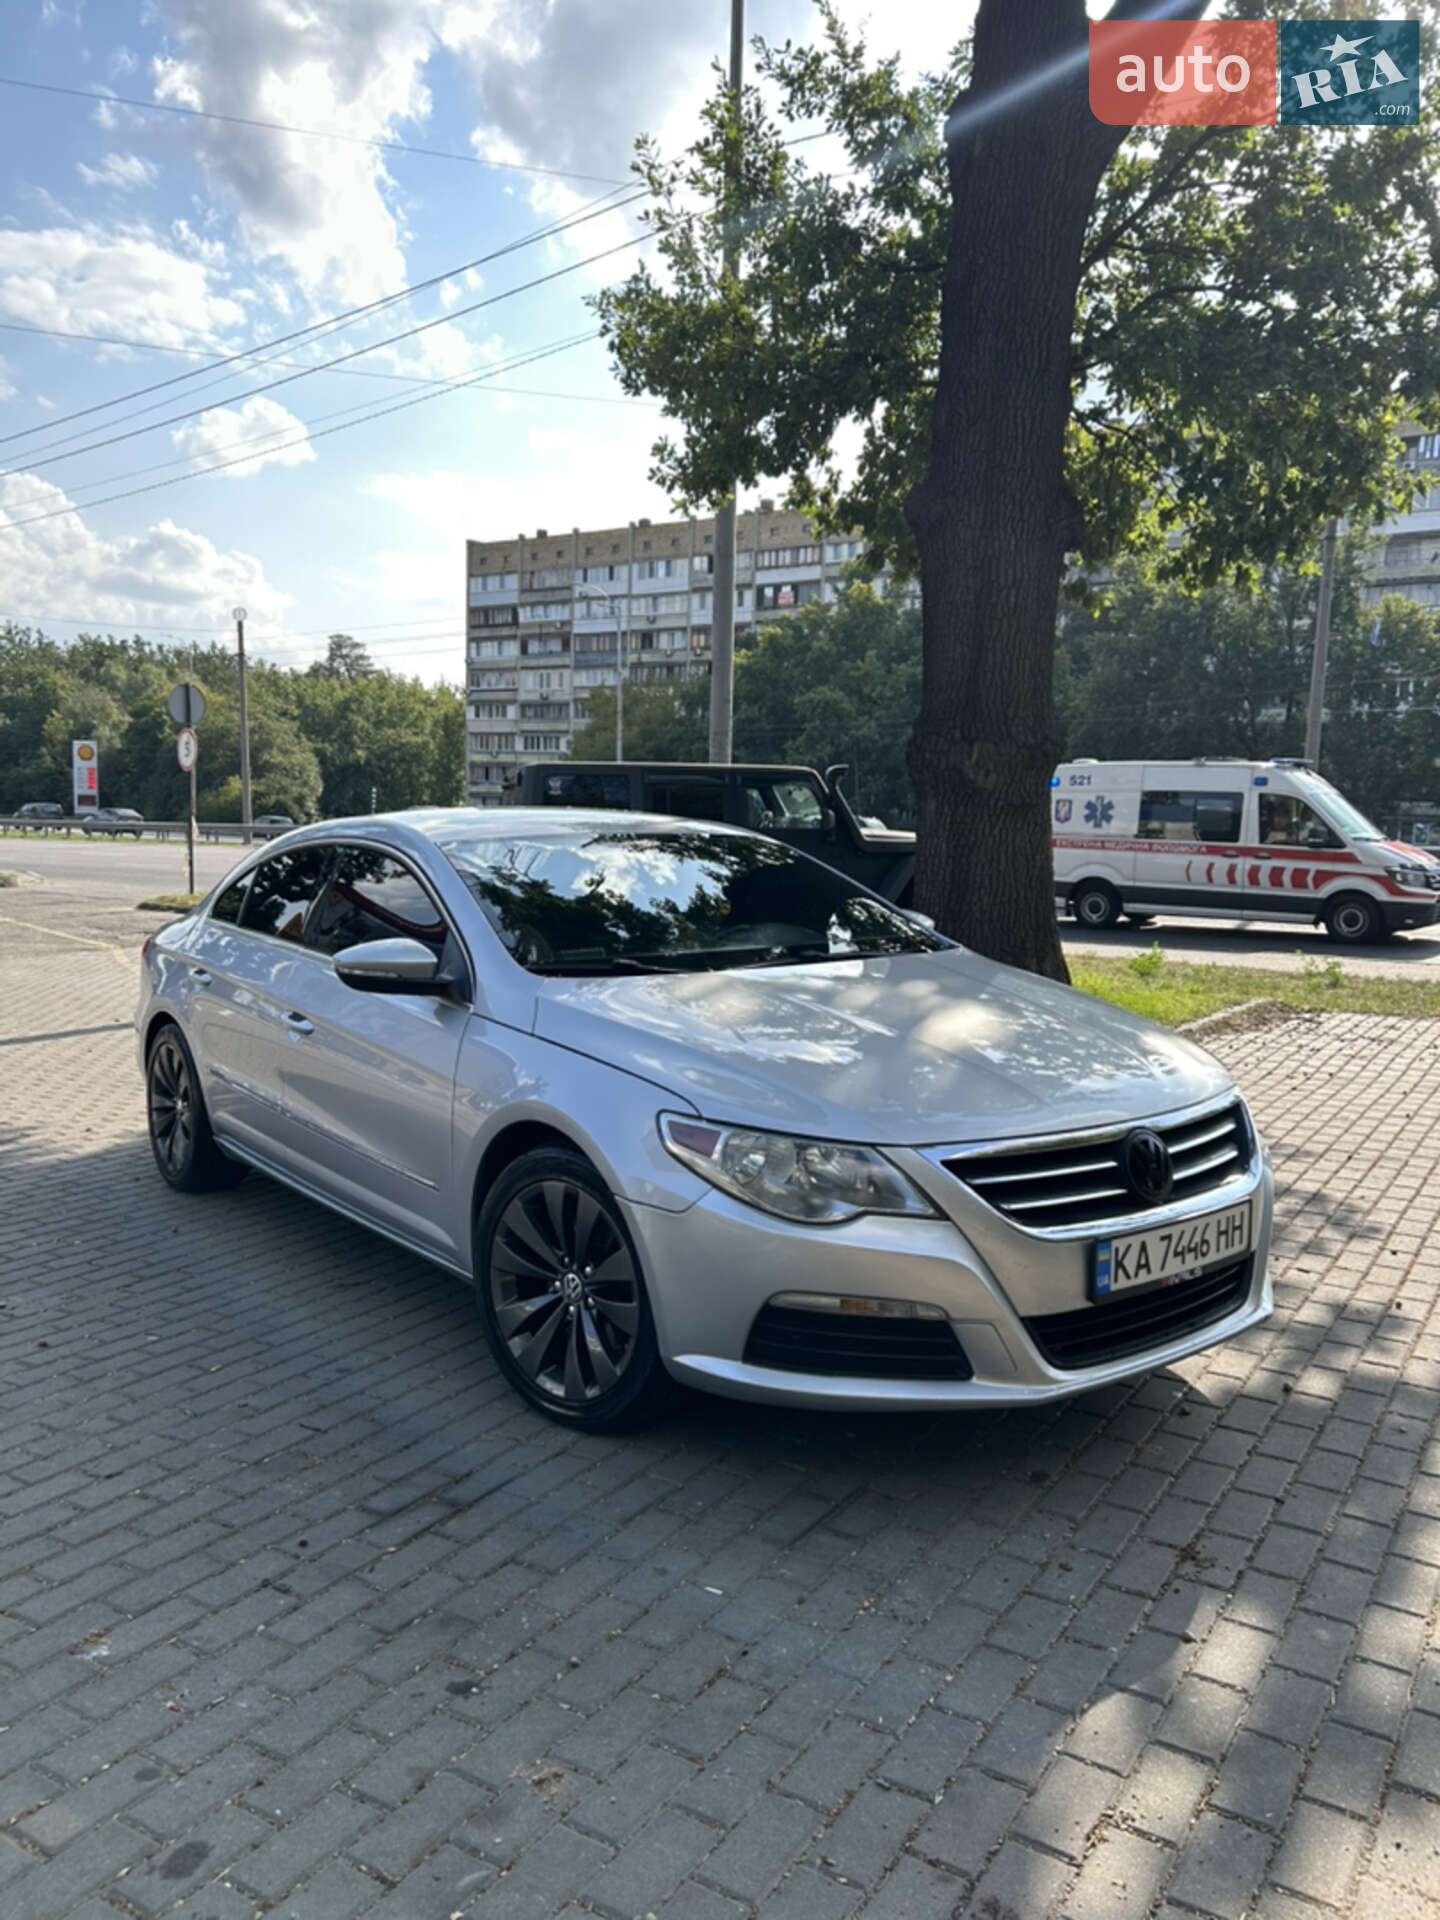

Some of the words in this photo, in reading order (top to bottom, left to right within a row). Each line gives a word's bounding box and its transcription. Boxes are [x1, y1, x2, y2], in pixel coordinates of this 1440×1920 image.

[1069, 774, 1092, 786] 521
[1113, 1240, 1151, 1283] KA
[1160, 1222, 1211, 1272] 7446
[1216, 1212, 1244, 1253] HH
